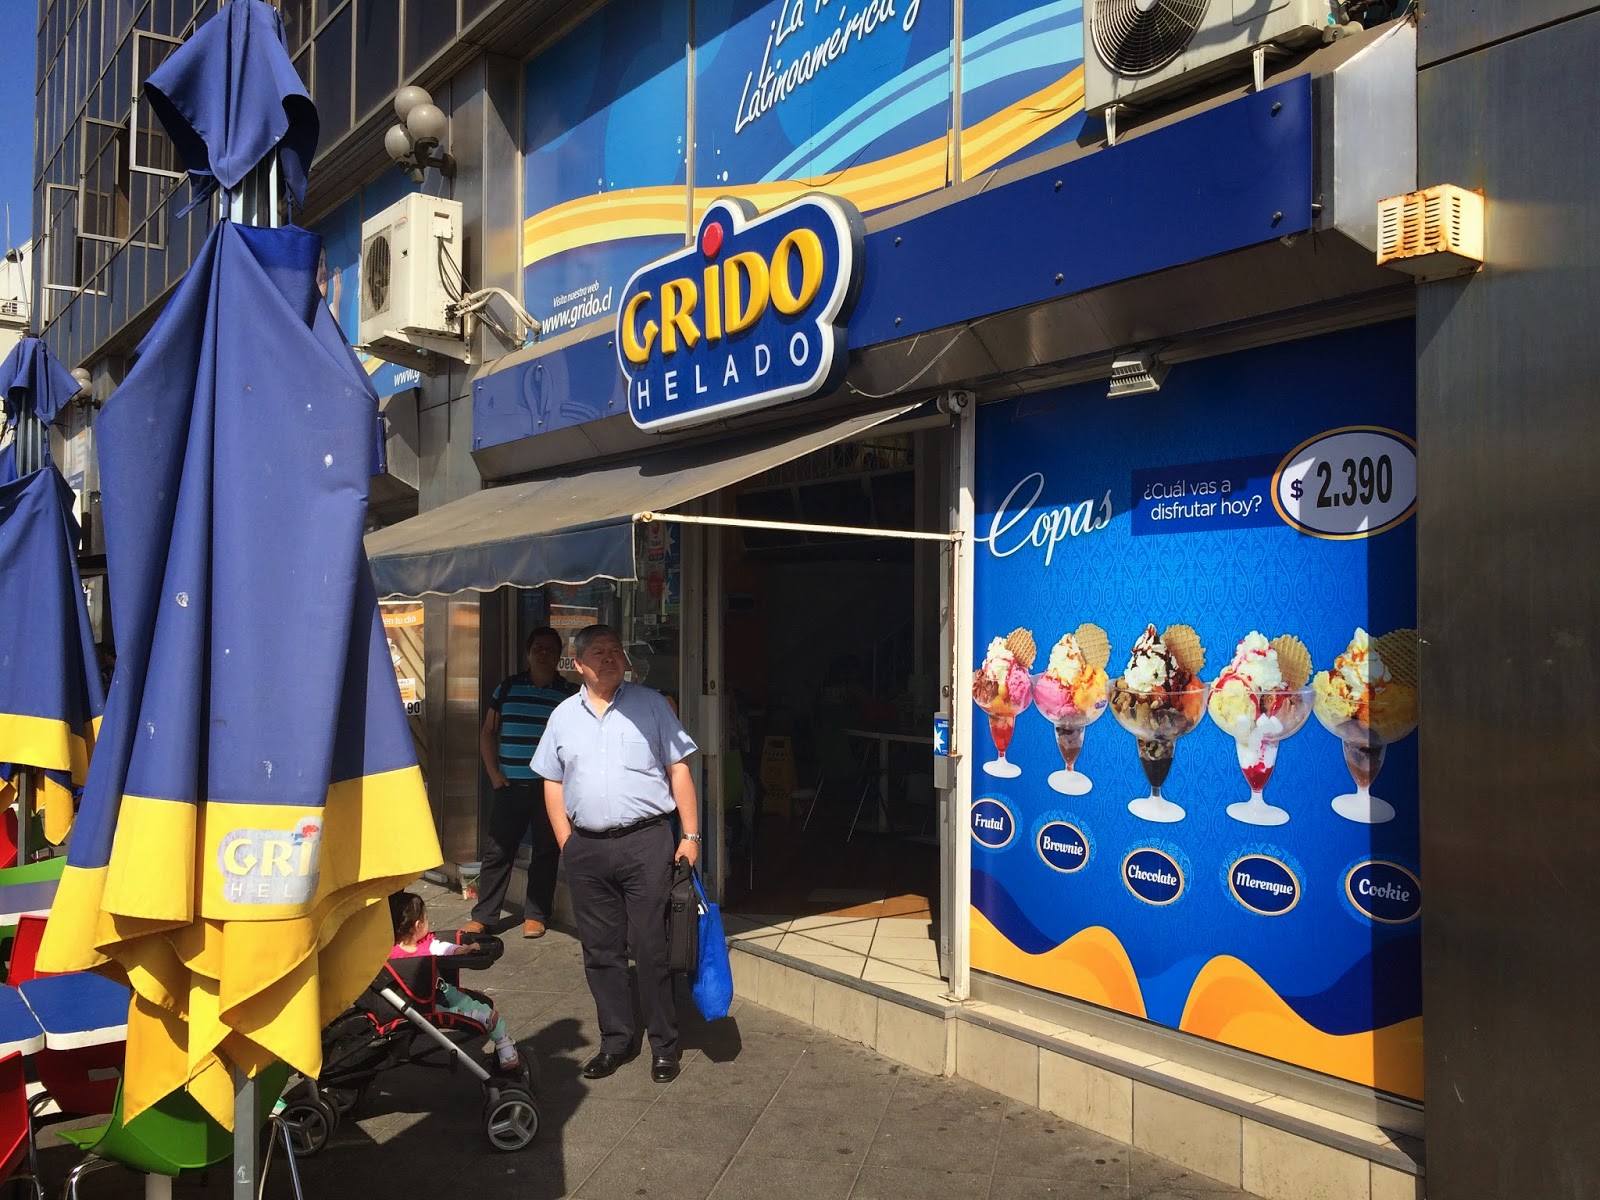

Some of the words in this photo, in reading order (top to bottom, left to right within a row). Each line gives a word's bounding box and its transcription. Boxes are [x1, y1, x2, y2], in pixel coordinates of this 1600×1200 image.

[734, 0, 895, 134] Latinoamérica
[587, 279, 600, 294] web
[621, 222, 825, 364] GRIDO
[541, 286, 613, 335] www.grido.cl
[393, 368, 420, 387] www.g
[637, 331, 810, 410] HELADO
[1143, 480, 1186, 500] ¿Cuál
[1190, 481, 1217, 496] vas
[1221, 479, 1231, 493] a
[1315, 453, 1394, 508] 2.390
[973, 472, 1112, 566] Copas
[1150, 501, 1218, 521] disfrutar
[1220, 494, 1263, 517] hoy?
[974, 813, 1004, 831] Frutal
[1042, 835, 1083, 857] Brownie
[1127, 863, 1177, 887] Chocolate
[1235, 872, 1294, 896] Merengue
[1358, 878, 1410, 902] Cookie
